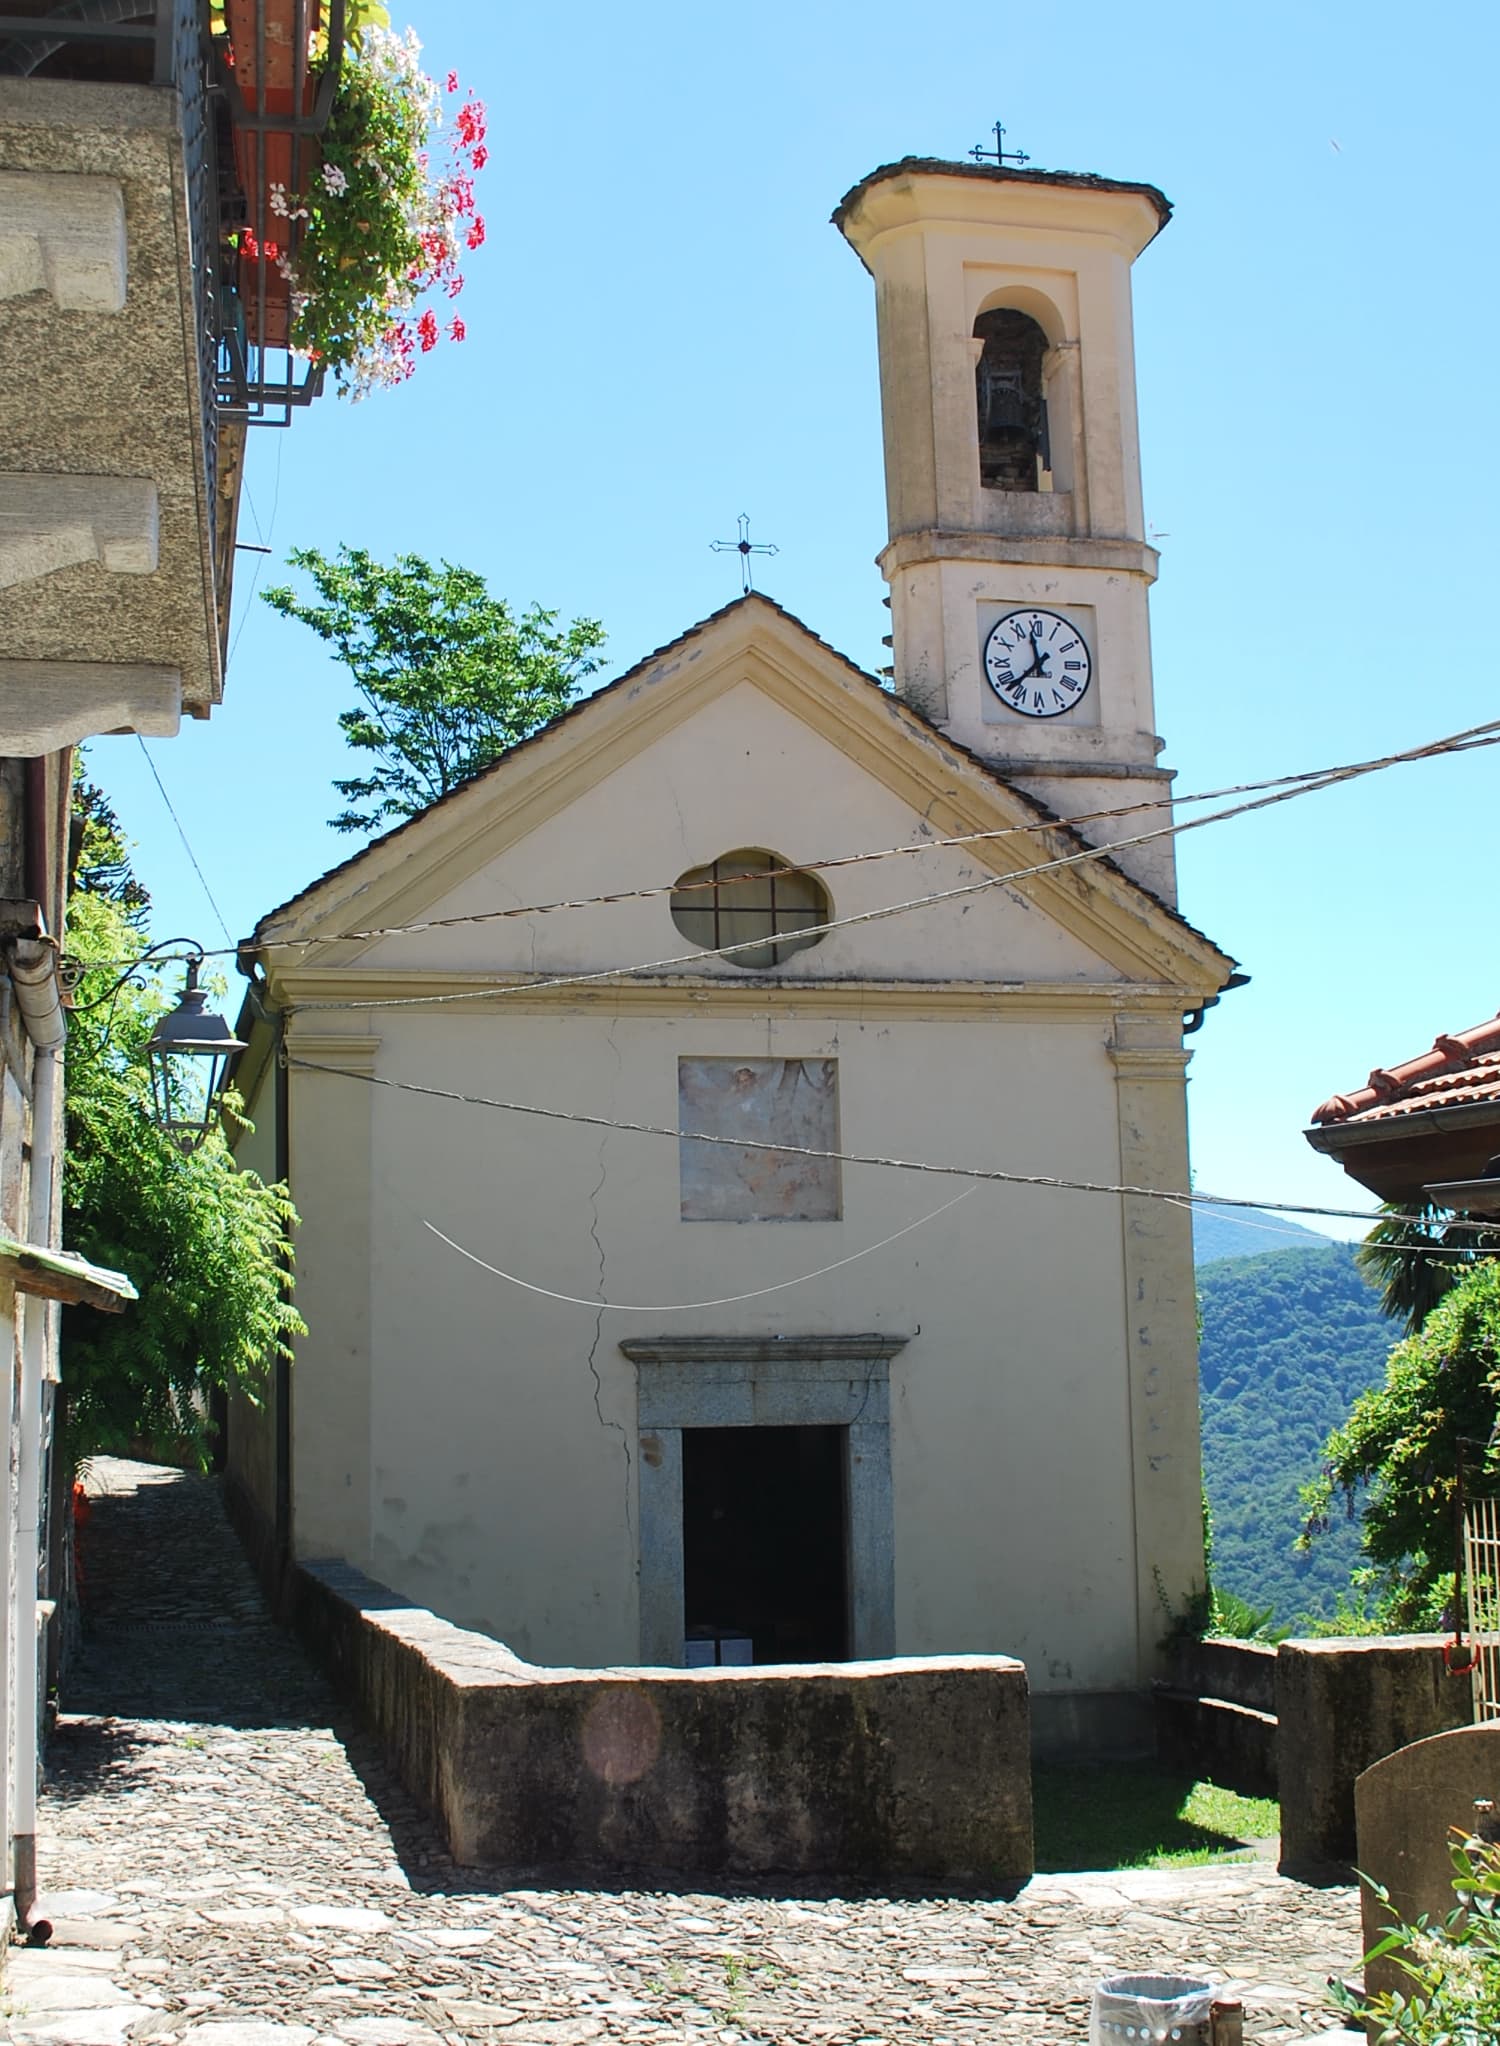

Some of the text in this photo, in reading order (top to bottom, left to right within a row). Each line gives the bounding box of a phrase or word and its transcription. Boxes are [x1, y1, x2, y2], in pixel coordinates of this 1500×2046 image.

[1010, 623, 1026, 641] XI
[1049, 627, 1058, 641] I
[997, 637, 1015, 652] X
[1059, 642, 1074, 653] II
[994, 656, 1011, 668] IX
[1064, 661, 1081, 670] III
[1012, 685, 1027, 704] VII
[1034, 691, 1045, 708] VI
[1051, 688, 1064, 705] V
